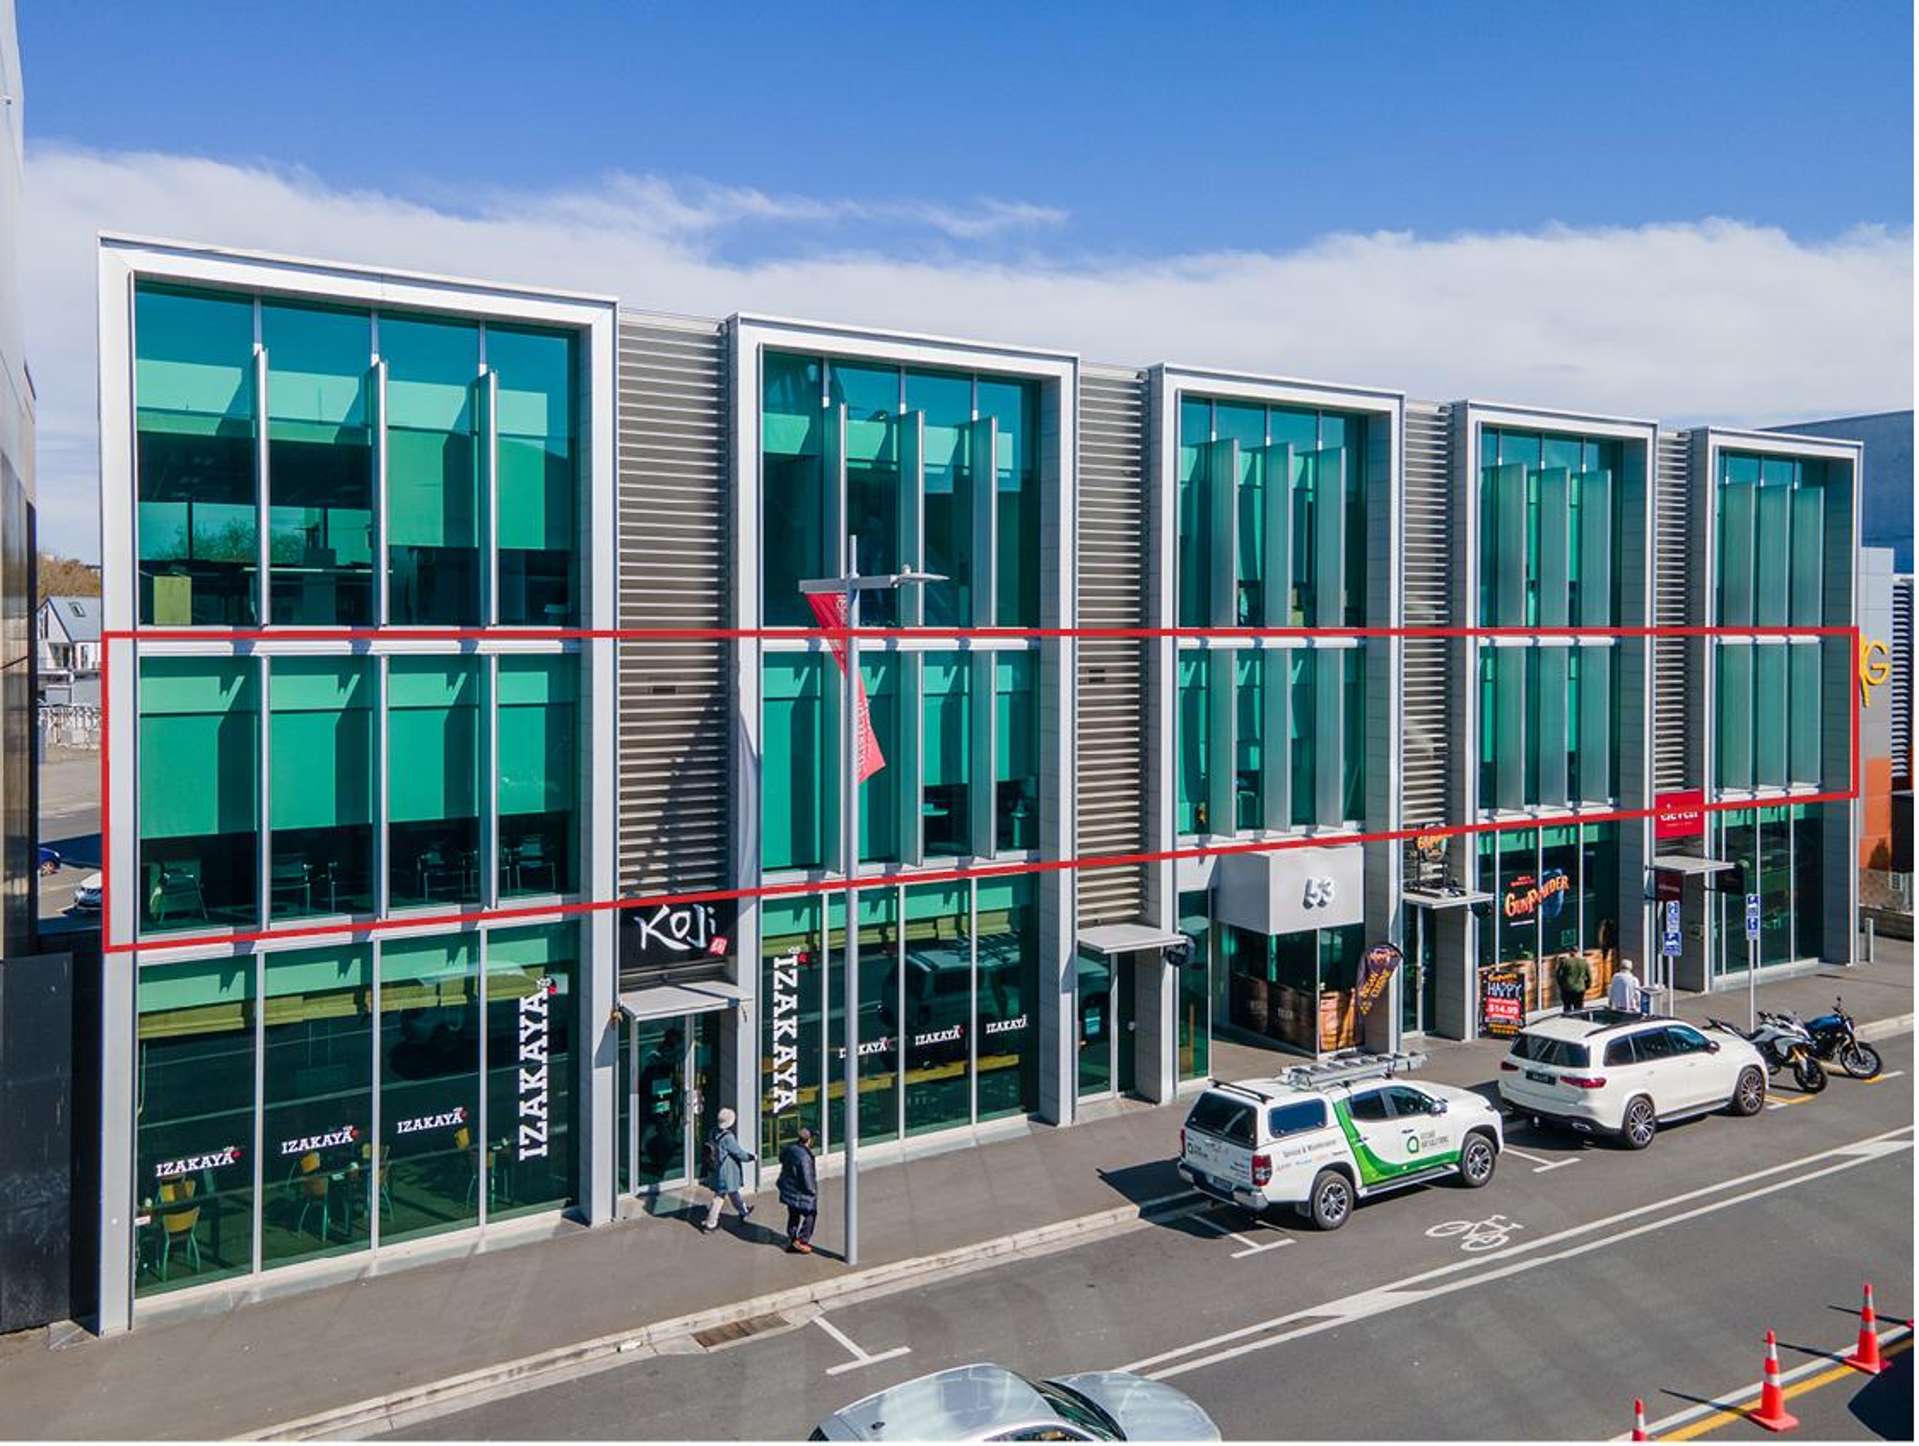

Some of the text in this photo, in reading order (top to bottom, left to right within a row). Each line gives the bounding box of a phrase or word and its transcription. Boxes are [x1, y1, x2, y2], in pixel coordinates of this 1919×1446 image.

[1488, 982, 1522, 998] HAPPY
[773, 956, 798, 1114] IZAKAYA
[915, 1029, 961, 1046] IZAKAYA
[519, 988, 548, 1161] IZAKAYA
[397, 1112, 464, 1134] IZAKAYA
[281, 1132, 354, 1155] IZAKAYA
[156, 1153, 236, 1177] IZAKAYA
